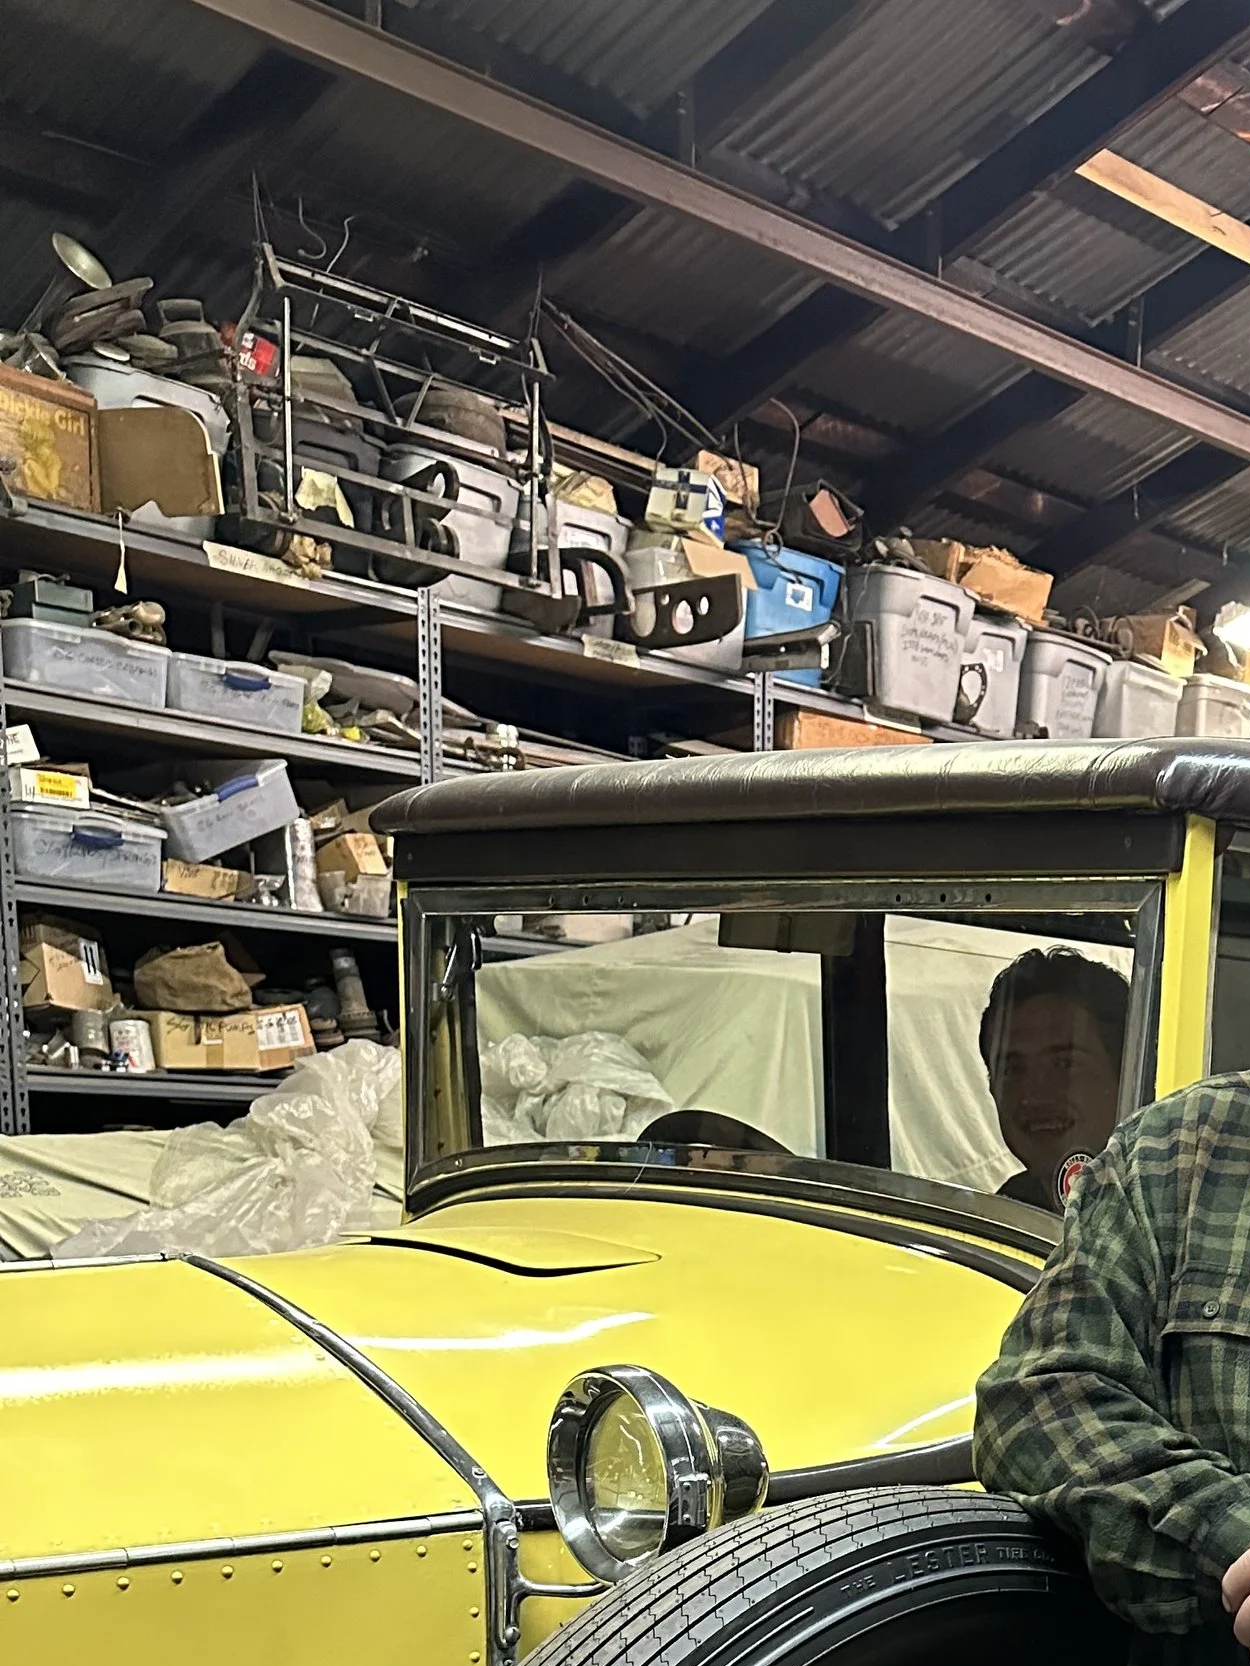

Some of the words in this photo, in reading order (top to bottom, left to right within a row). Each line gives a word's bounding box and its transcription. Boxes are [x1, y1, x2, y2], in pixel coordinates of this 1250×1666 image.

[54, 409, 86, 437] Girl
[839, 1573, 877, 1599] THE
[886, 1543, 988, 1585] LESTER
[996, 1546, 1029, 1560] TIRE
